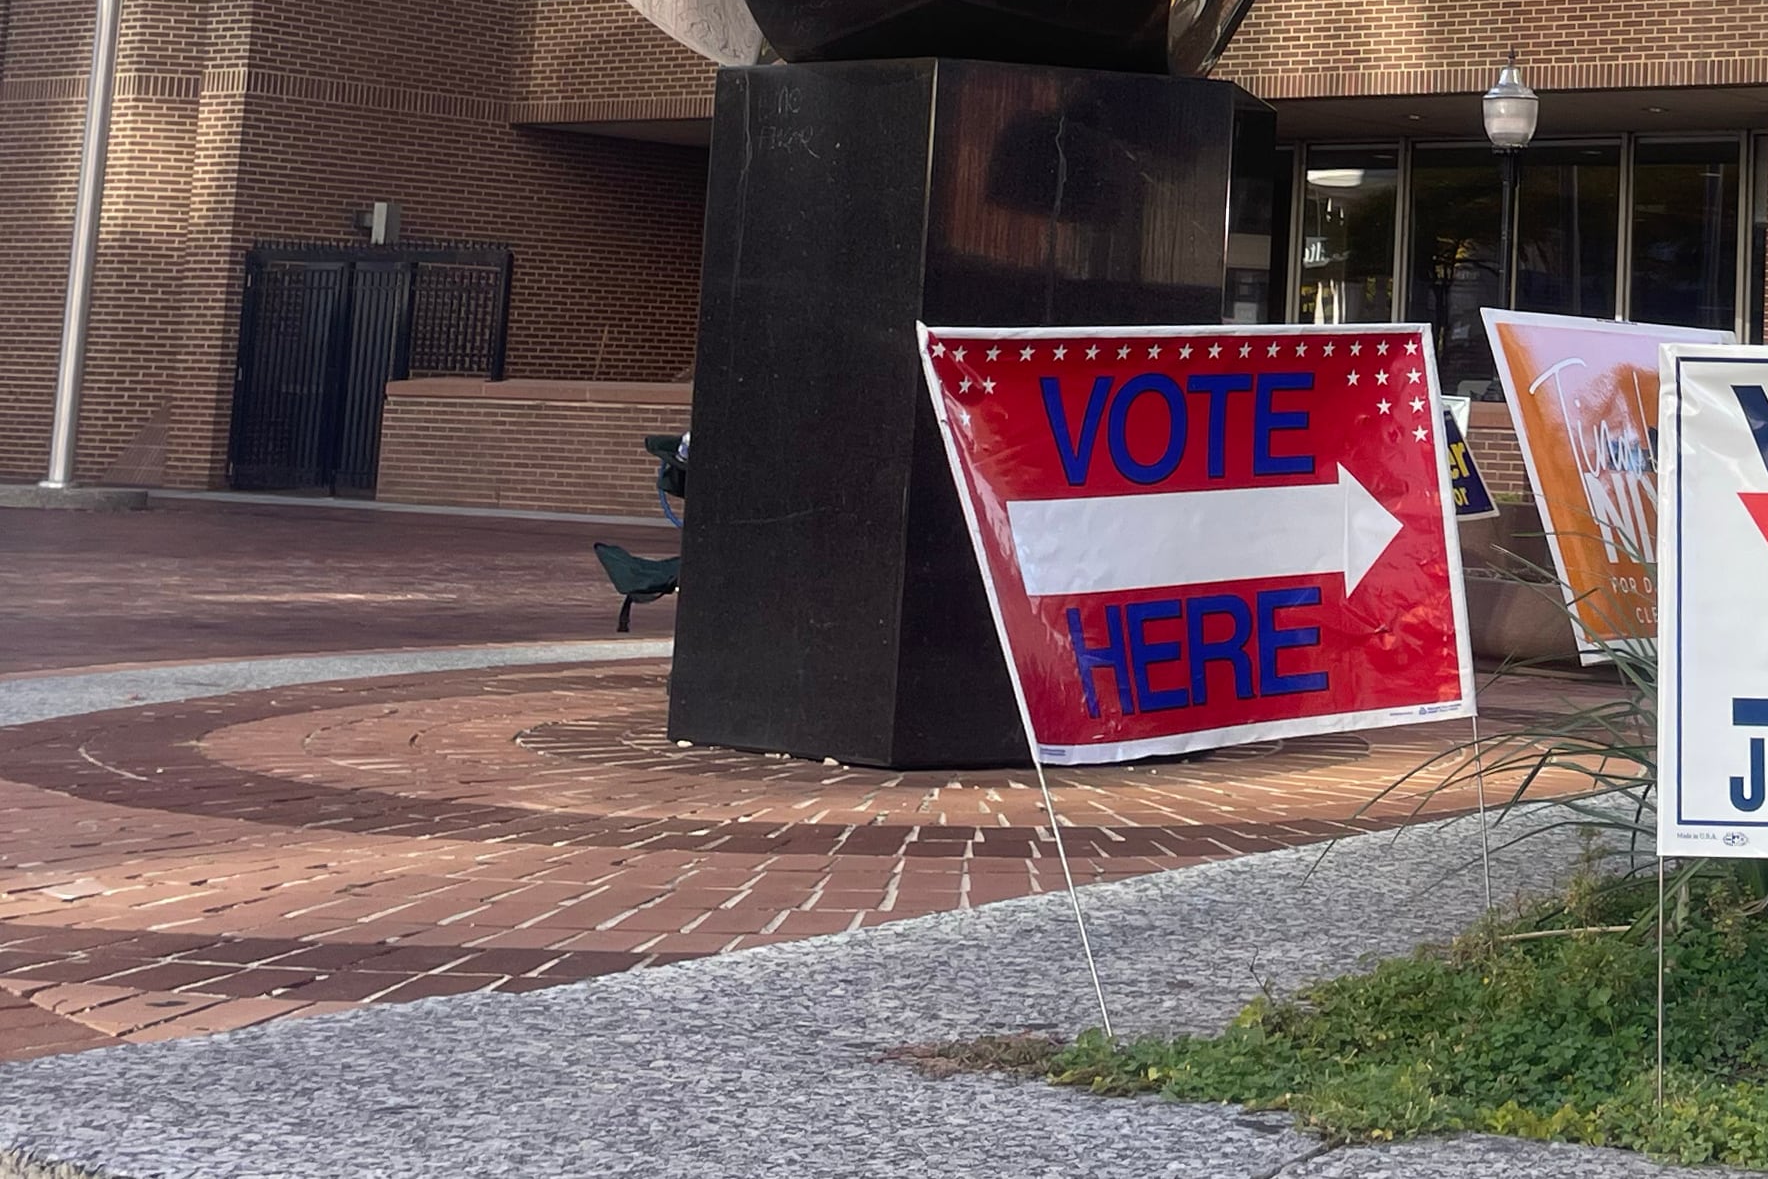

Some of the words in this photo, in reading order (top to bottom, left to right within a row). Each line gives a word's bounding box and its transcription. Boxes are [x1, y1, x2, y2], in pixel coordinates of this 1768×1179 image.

[1040, 372, 1316, 486] VOTE
[1066, 586, 1330, 718] HERE
[1635, 607, 1658, 623] CLE
